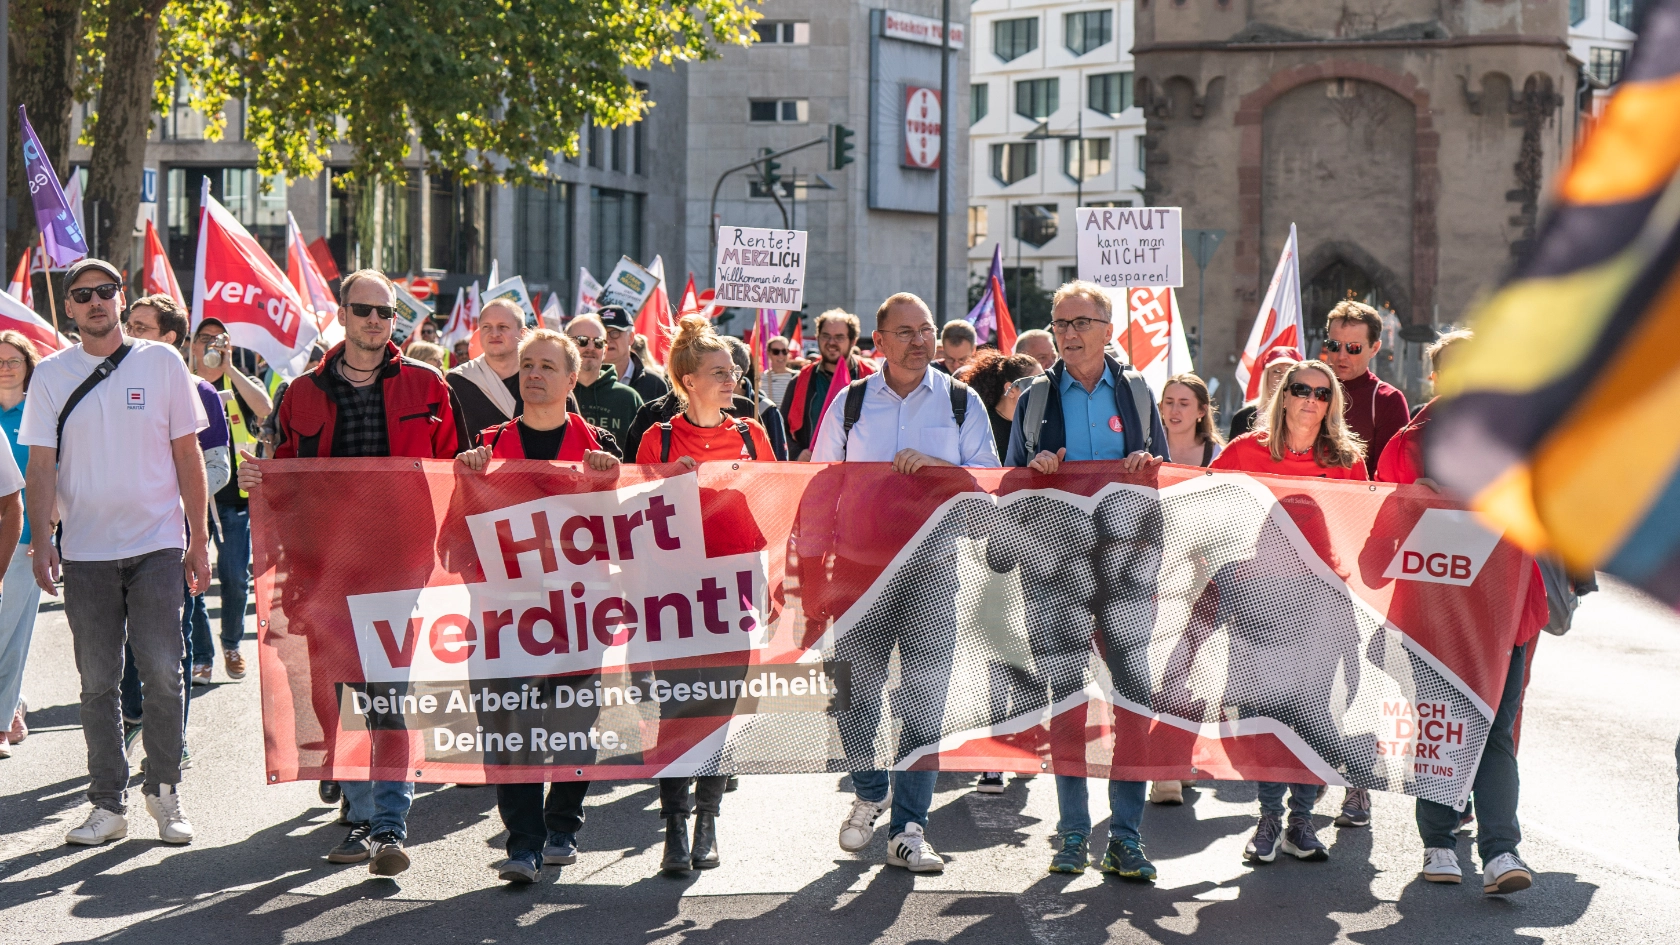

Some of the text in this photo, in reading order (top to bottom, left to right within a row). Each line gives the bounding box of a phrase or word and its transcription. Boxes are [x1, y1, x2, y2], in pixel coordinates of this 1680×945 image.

[932, 24, 963, 42] TUOR
[907, 119, 941, 136] TUDOR
[145, 171, 156, 201] U
[1085, 209, 1169, 230] ARMUT
[733, 229, 795, 249] Rente?
[1097, 234, 1165, 248] kann man
[722, 248, 800, 268] MERZLICH
[1101, 248, 1160, 265] NICHT
[718, 267, 797, 285] Willkommen in der
[1093, 265, 1169, 287] wegsparen!
[716, 283, 800, 304] ALTERSARMUT
[203, 278, 297, 333] ver.di
[587, 417, 620, 429] DEN
[494, 495, 681, 579] Hart
[1402, 551, 1472, 580] DGB
[373, 571, 757, 669] verdient!
[352, 668, 839, 715] Deine Arbeit. Deine Gesundheit.
[1383, 701, 1445, 719] MACH
[434, 726, 628, 752] Deine Rente.
[1396, 718, 1463, 744] DICH
[1376, 740, 1441, 760] STARK
[1408, 762, 1454, 777] MIT UNS
